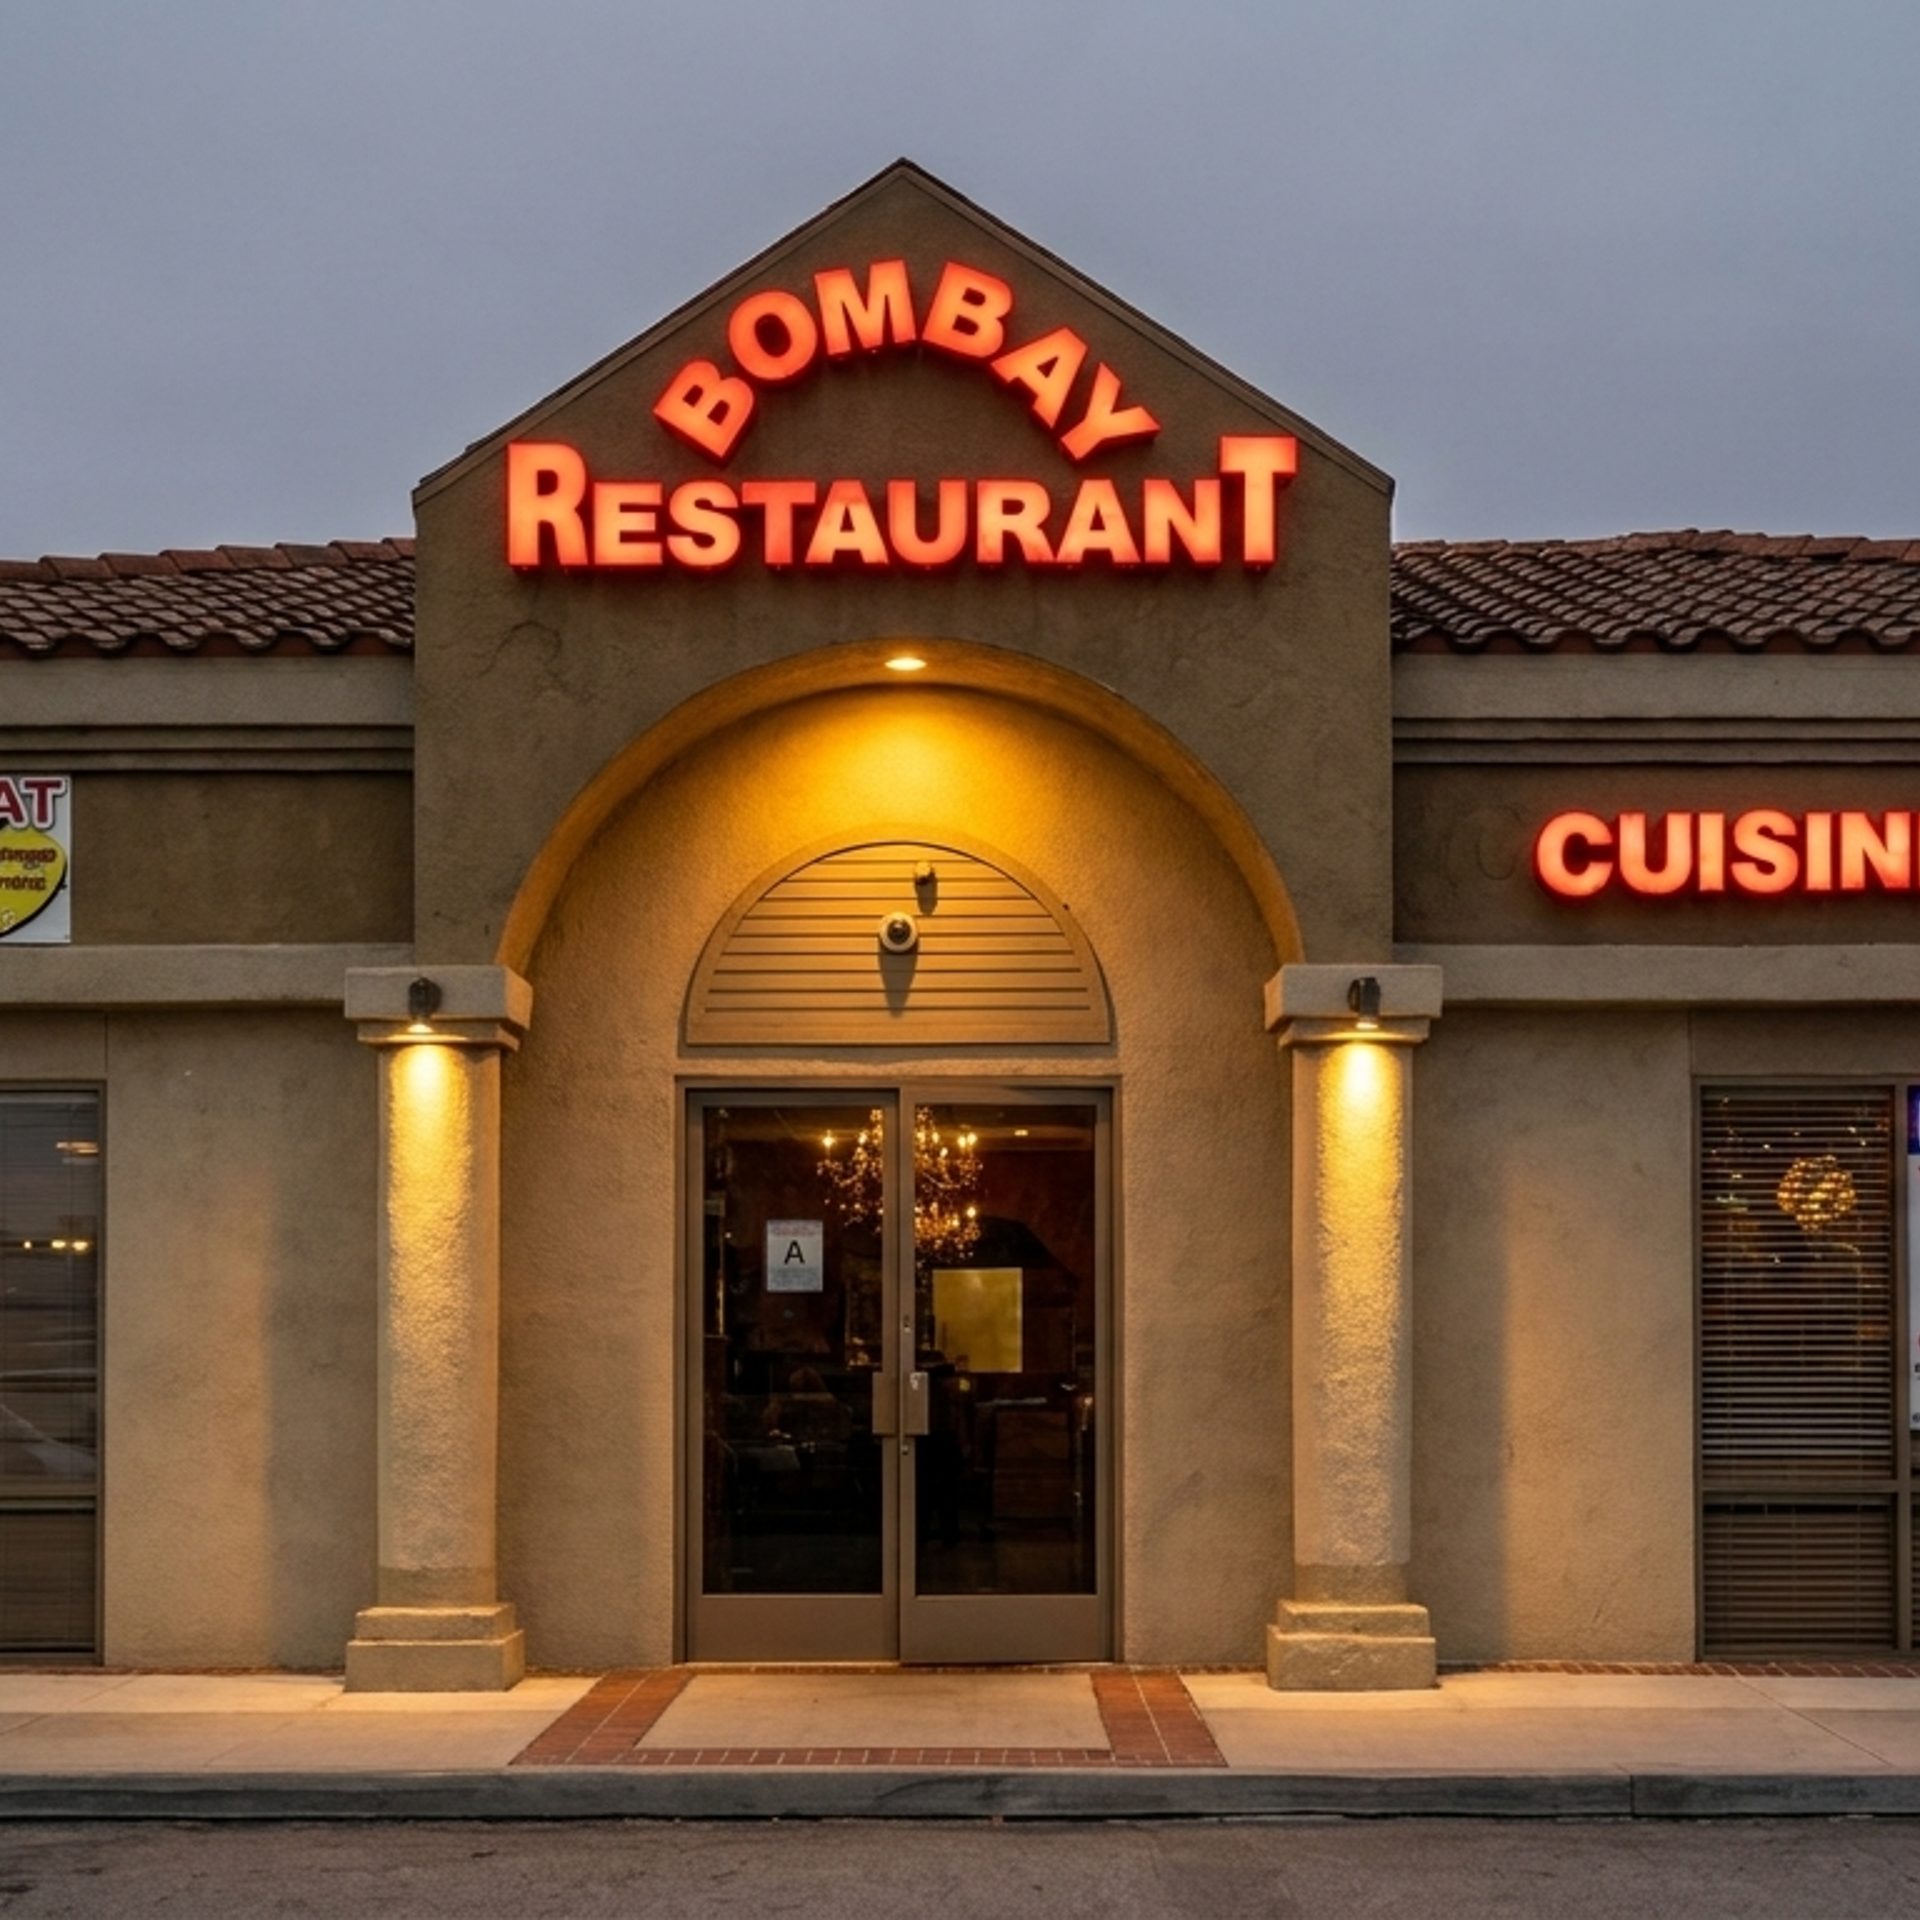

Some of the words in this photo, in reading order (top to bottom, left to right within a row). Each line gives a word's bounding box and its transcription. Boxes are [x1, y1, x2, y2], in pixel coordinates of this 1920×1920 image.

[653, 259, 1160, 465] BOMBAY
[507, 435, 1297, 568] RESTAURANT
[1536, 809, 1920, 896] CUISIN
[783, 1240, 806, 1265] A
